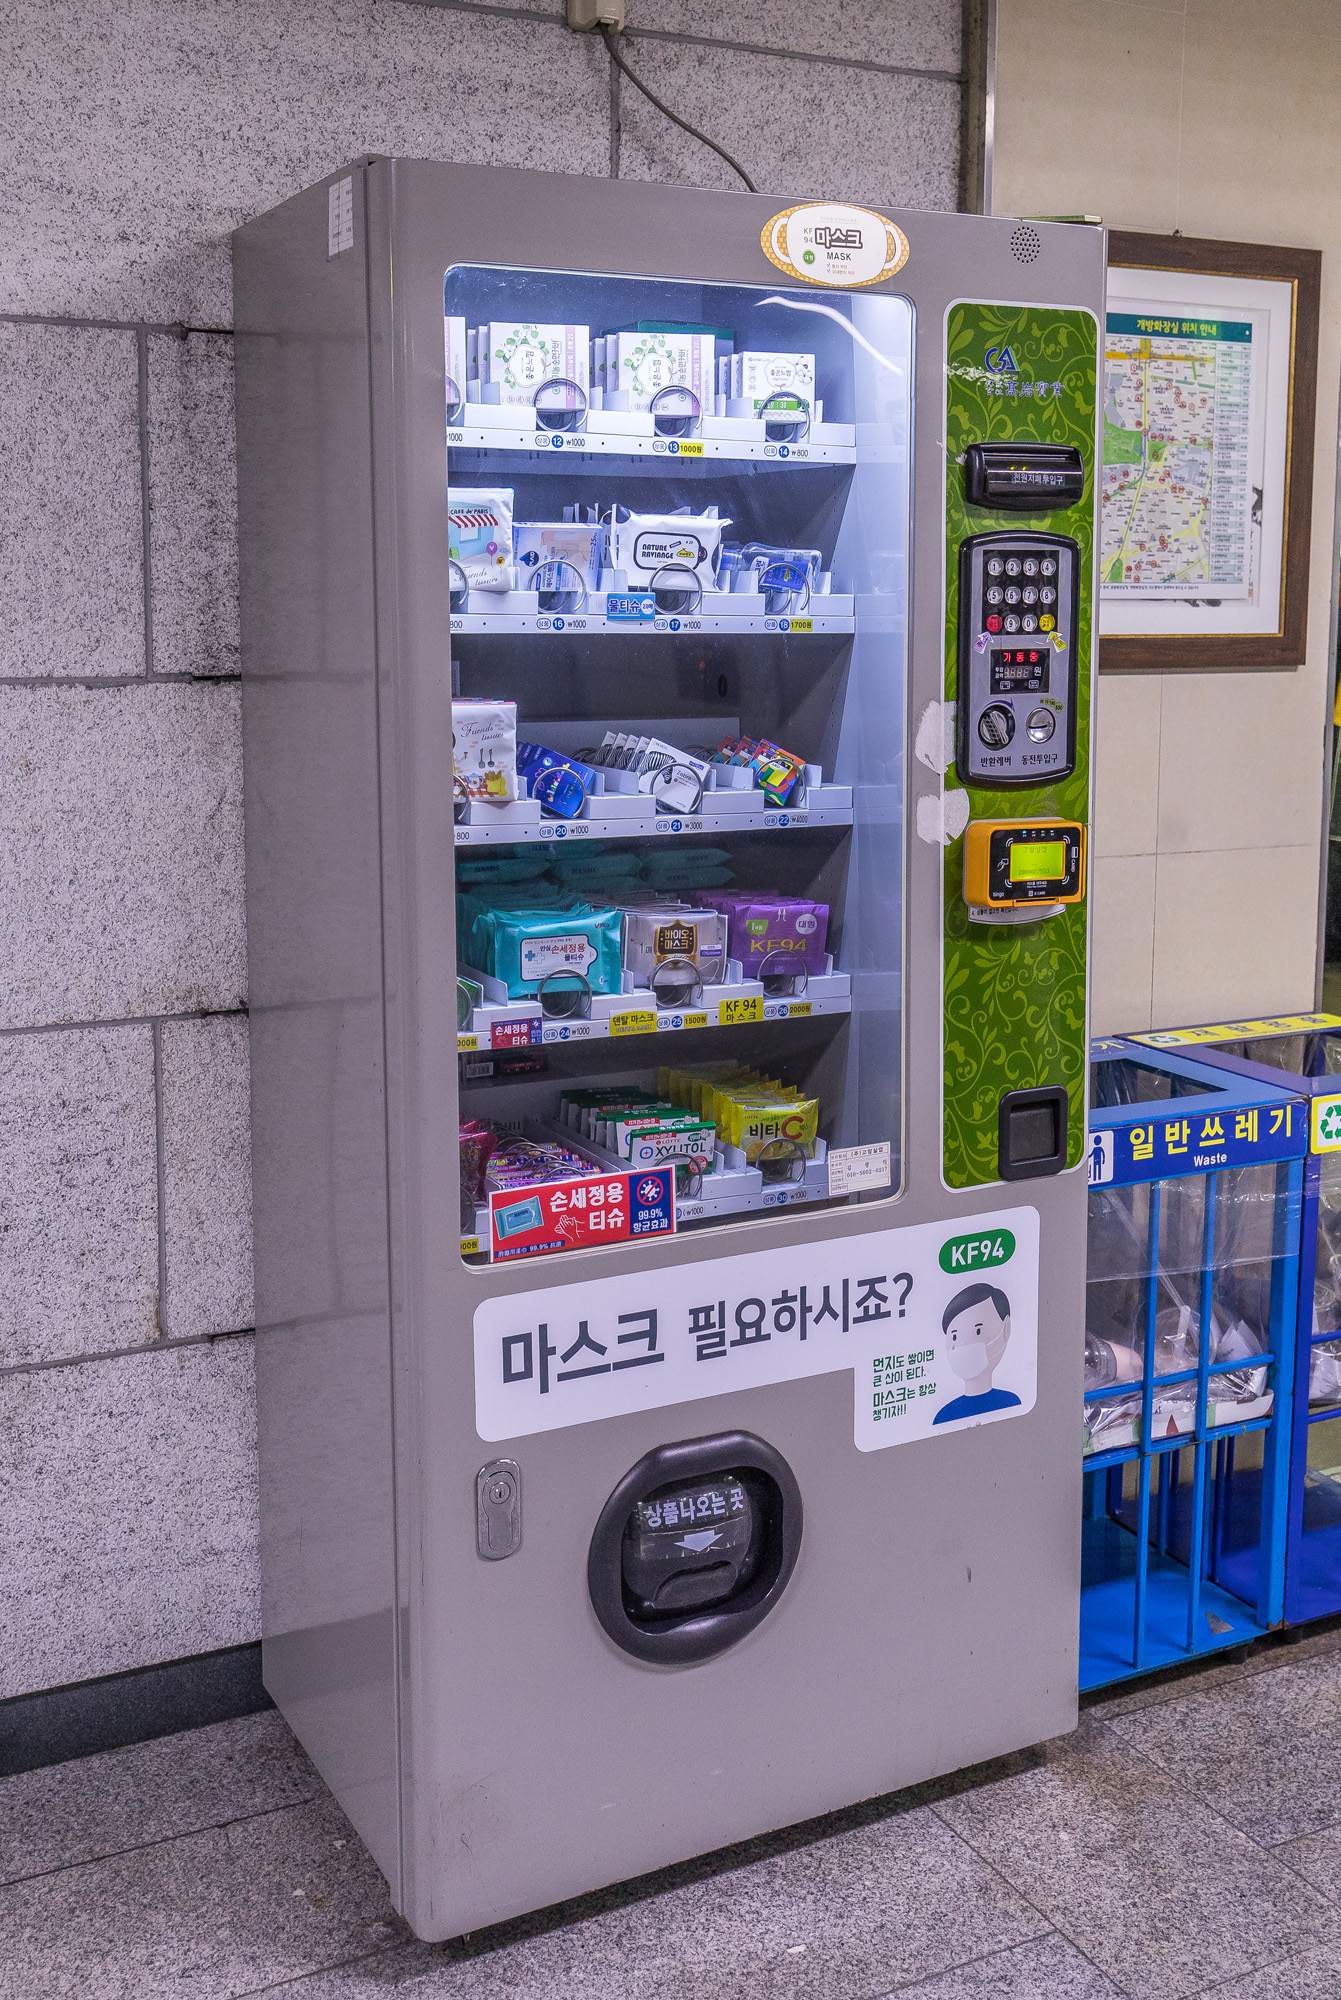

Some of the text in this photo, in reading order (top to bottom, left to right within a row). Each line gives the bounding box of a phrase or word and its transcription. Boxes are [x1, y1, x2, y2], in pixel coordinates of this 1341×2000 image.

[815, 227, 863, 249] 마스크
[827, 252, 851, 261] MASK
[1137, 319, 1216, 336] 개방화장실 위치 안내
[553, 437, 562, 446] 12
[669, 443, 678, 451] 13
[680, 445, 702, 453] 1000원
[780, 448, 788, 456] 14
[642, 543, 669, 551] NATURE
[608, 598, 640, 613] 물티슈
[554, 619, 563, 628] 16
[780, 621, 788, 629] 18
[791, 621, 812, 629] 1700원
[1034, 667, 1041, 676] 원
[981, 756, 1011, 767] 반환레버
[1021, 754, 1058, 765] 동전투입구
[676, 768, 692, 782] Zebra
[673, 822, 681, 830] 21
[779, 816, 789, 825] 22
[556, 827, 566, 836] 20
[475, 864, 499, 872] HANDS
[798, 920, 815, 929] 대형
[665, 930, 689, 939] 바이오
[551, 944, 586, 954] 손세정용
[665, 940, 689, 949] 마스크
[750, 939, 806, 952] KF94
[726, 999, 757, 1011] KF 94
[779, 1007, 788, 1015] 26
[790, 1004, 810, 1013] 2000원
[613, 1014, 654, 1026] 덴탈 마스크
[672, 1018, 681, 1026] 25
[685, 1015, 707, 1024] 1500원
[726, 1012, 756, 1021] 마스크
[495, 1024, 528, 1035] 손세정용
[546, 1030, 556, 1039] 상품
[561, 1029, 569, 1038] 24
[512, 1036, 528, 1045] 티슈
[655, 1142, 706, 1157] XYLITOL
[1194, 1153, 1227, 1167] Waste
[550, 1182, 624, 1212] 손세정용
[778, 1193, 787, 1202] 30
[589, 1208, 625, 1230] 티슈
[638, 1208, 663, 1220] 99.9%
[633, 1218, 668, 1232] 항균효과
[530, 1244, 548, 1252] 99.9%
[951, 1237, 1004, 1267] KF94
[502, 1272, 914, 1394] 마스크 필요하시죠?
[873, 1349, 935, 1373] 먼지도 쌓이면
[873, 1367, 926, 1387] 큰 산이 된다.
[873, 1382, 936, 1407] 마스크는 항상
[873, 1404, 907, 1421] 챙기자!!
[646, 1488, 744, 1528] 상품나오는 곳
